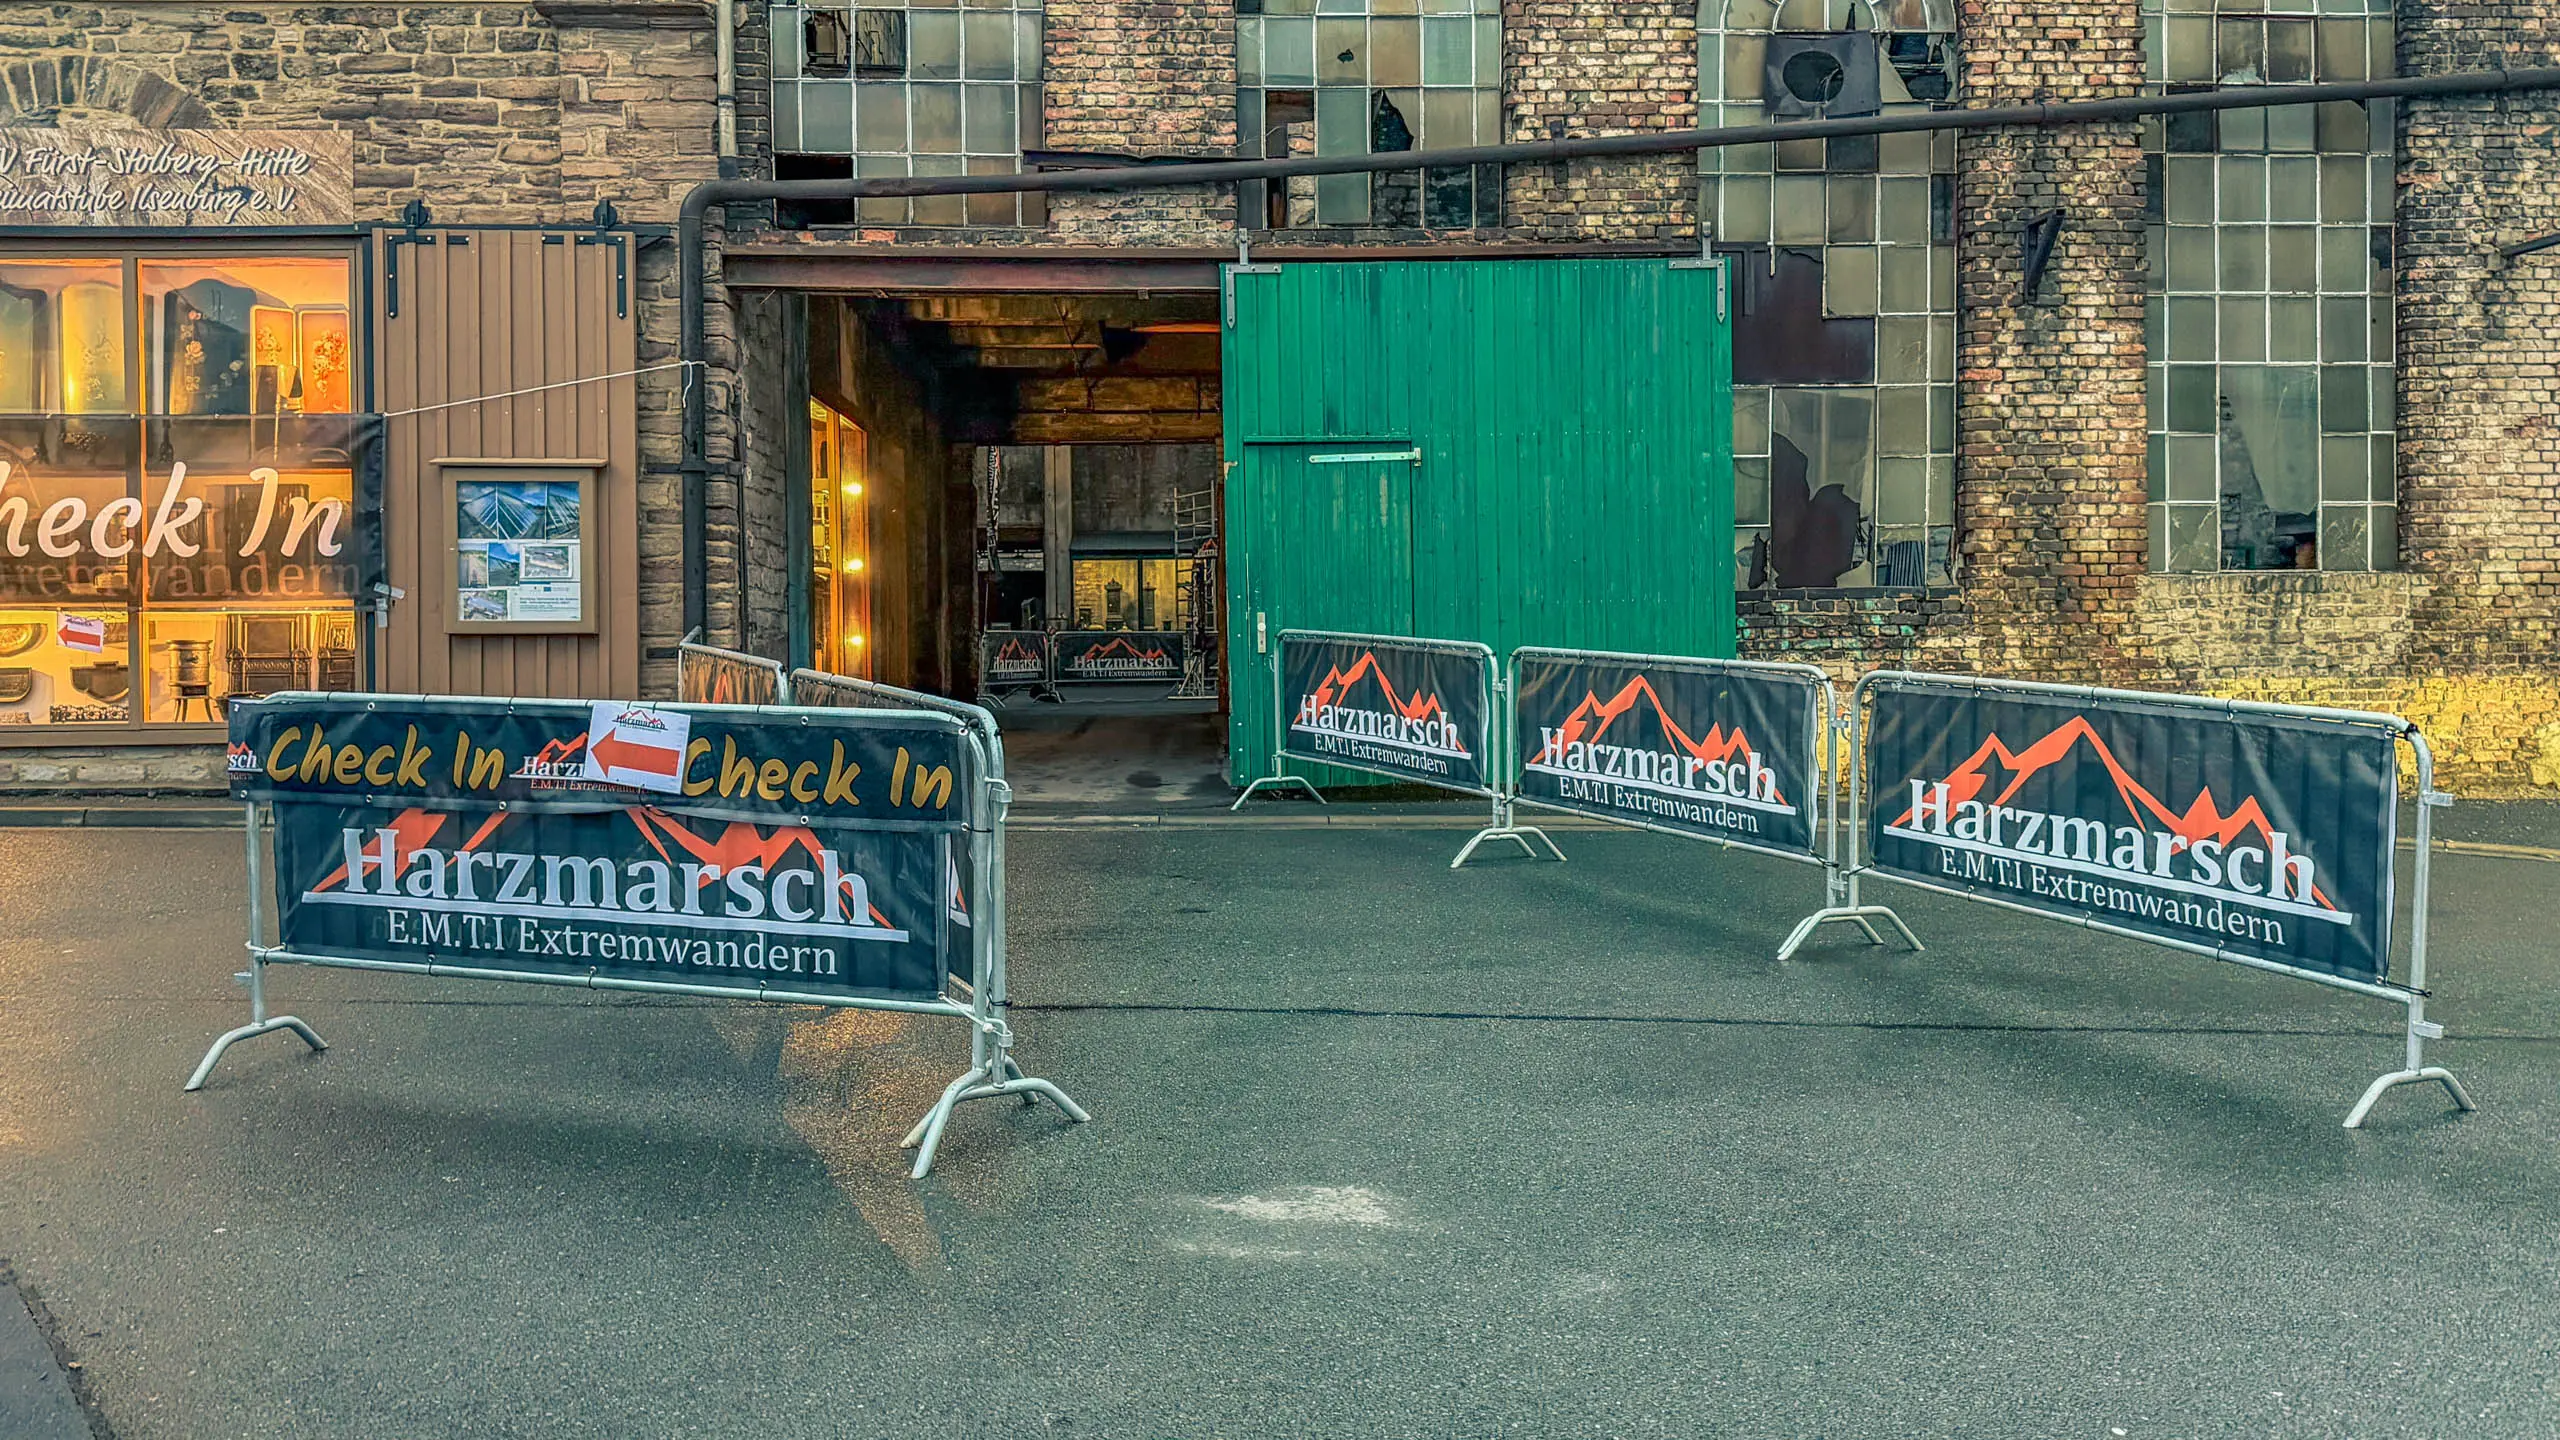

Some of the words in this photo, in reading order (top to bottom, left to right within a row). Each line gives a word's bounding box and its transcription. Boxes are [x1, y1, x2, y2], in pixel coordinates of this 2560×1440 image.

[25, 144, 310, 184] Fürst-Stolberg-Hütte
[0, 181, 125, 211] imatstube
[130, 182, 247, 225] Ilsenburg
[252, 187, 297, 212] e.V.
[238, 467, 344, 558] In
[1074, 654, 1173, 670] Harzmarsch
[1109, 669, 1168, 678] Extremwandern
[266, 721, 432, 788] Check
[452, 730, 506, 791] In
[1300, 694, 1459, 751] Harzmarsch
[1314, 733, 1350, 755] E.M.T.I
[1352, 740, 1449, 775] Extremwandern
[682, 733, 862, 805] Check
[890, 746, 954, 810] In
[1540, 727, 1777, 804] Harzmarsch
[1559, 776, 1610, 804] E.M.T.I
[1615, 785, 1759, 834] Extremwandern
[1909, 778, 2318, 906] Harzmarsch
[342, 827, 876, 927] Harzmarsch
[1941, 846, 2024, 889] E.M.T.I
[2031, 866, 2286, 946] Extremwandern
[387, 909, 505, 951] E.M.T.I
[518, 917, 838, 976] Extremwandern
